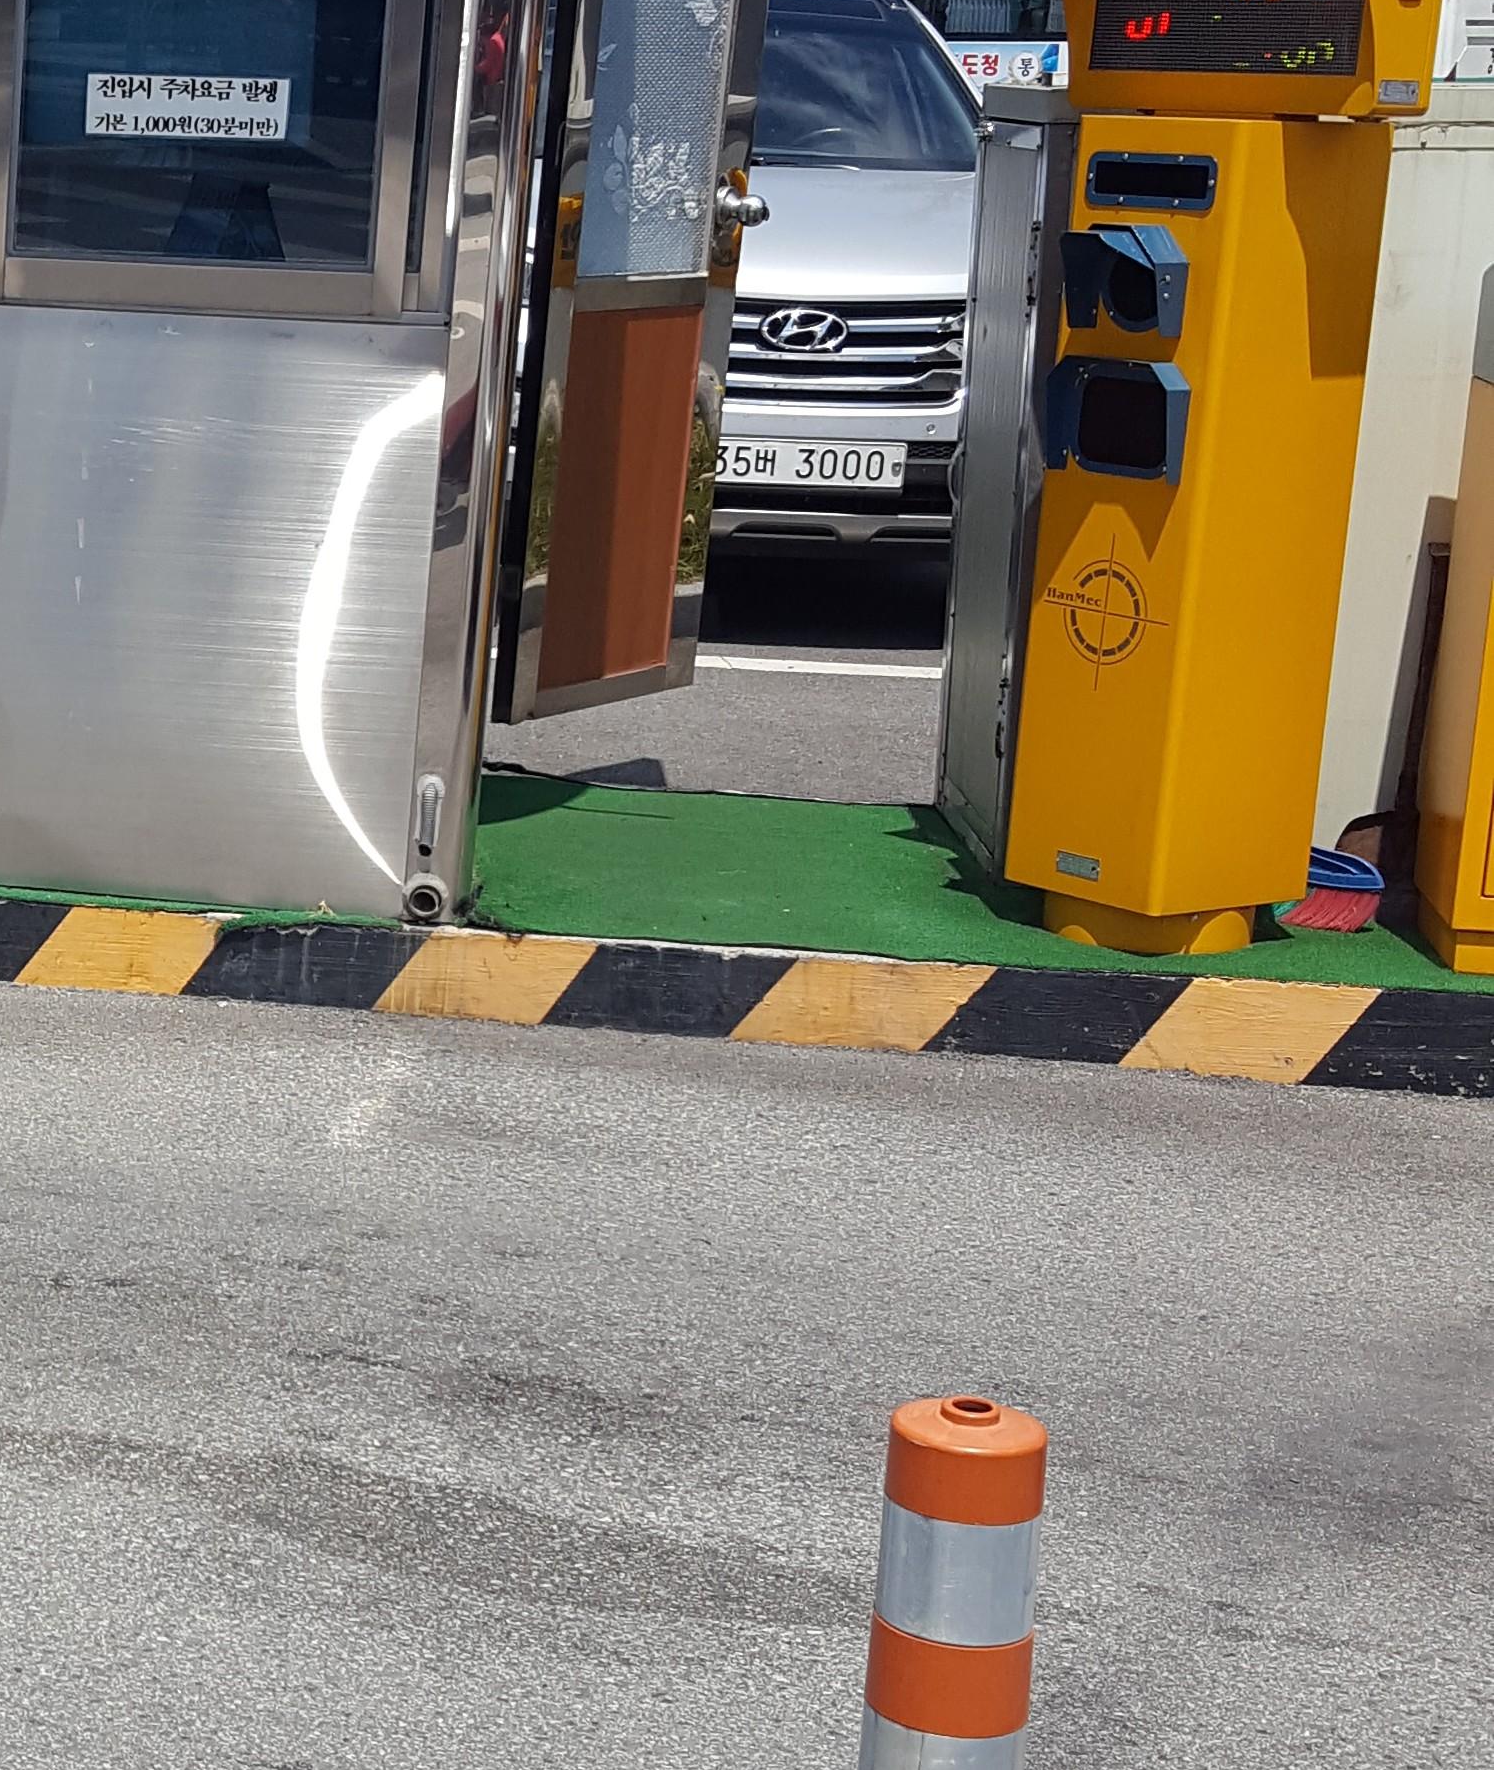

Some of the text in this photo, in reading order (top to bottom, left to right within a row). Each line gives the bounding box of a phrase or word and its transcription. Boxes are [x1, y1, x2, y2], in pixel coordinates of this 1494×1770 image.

[97, 76, 278, 103] 진입시 주차요금 발생
[94, 113, 127, 132] 기본
[795, 448, 885, 481] 3000
[1046, 587, 1102, 607] HanMec
